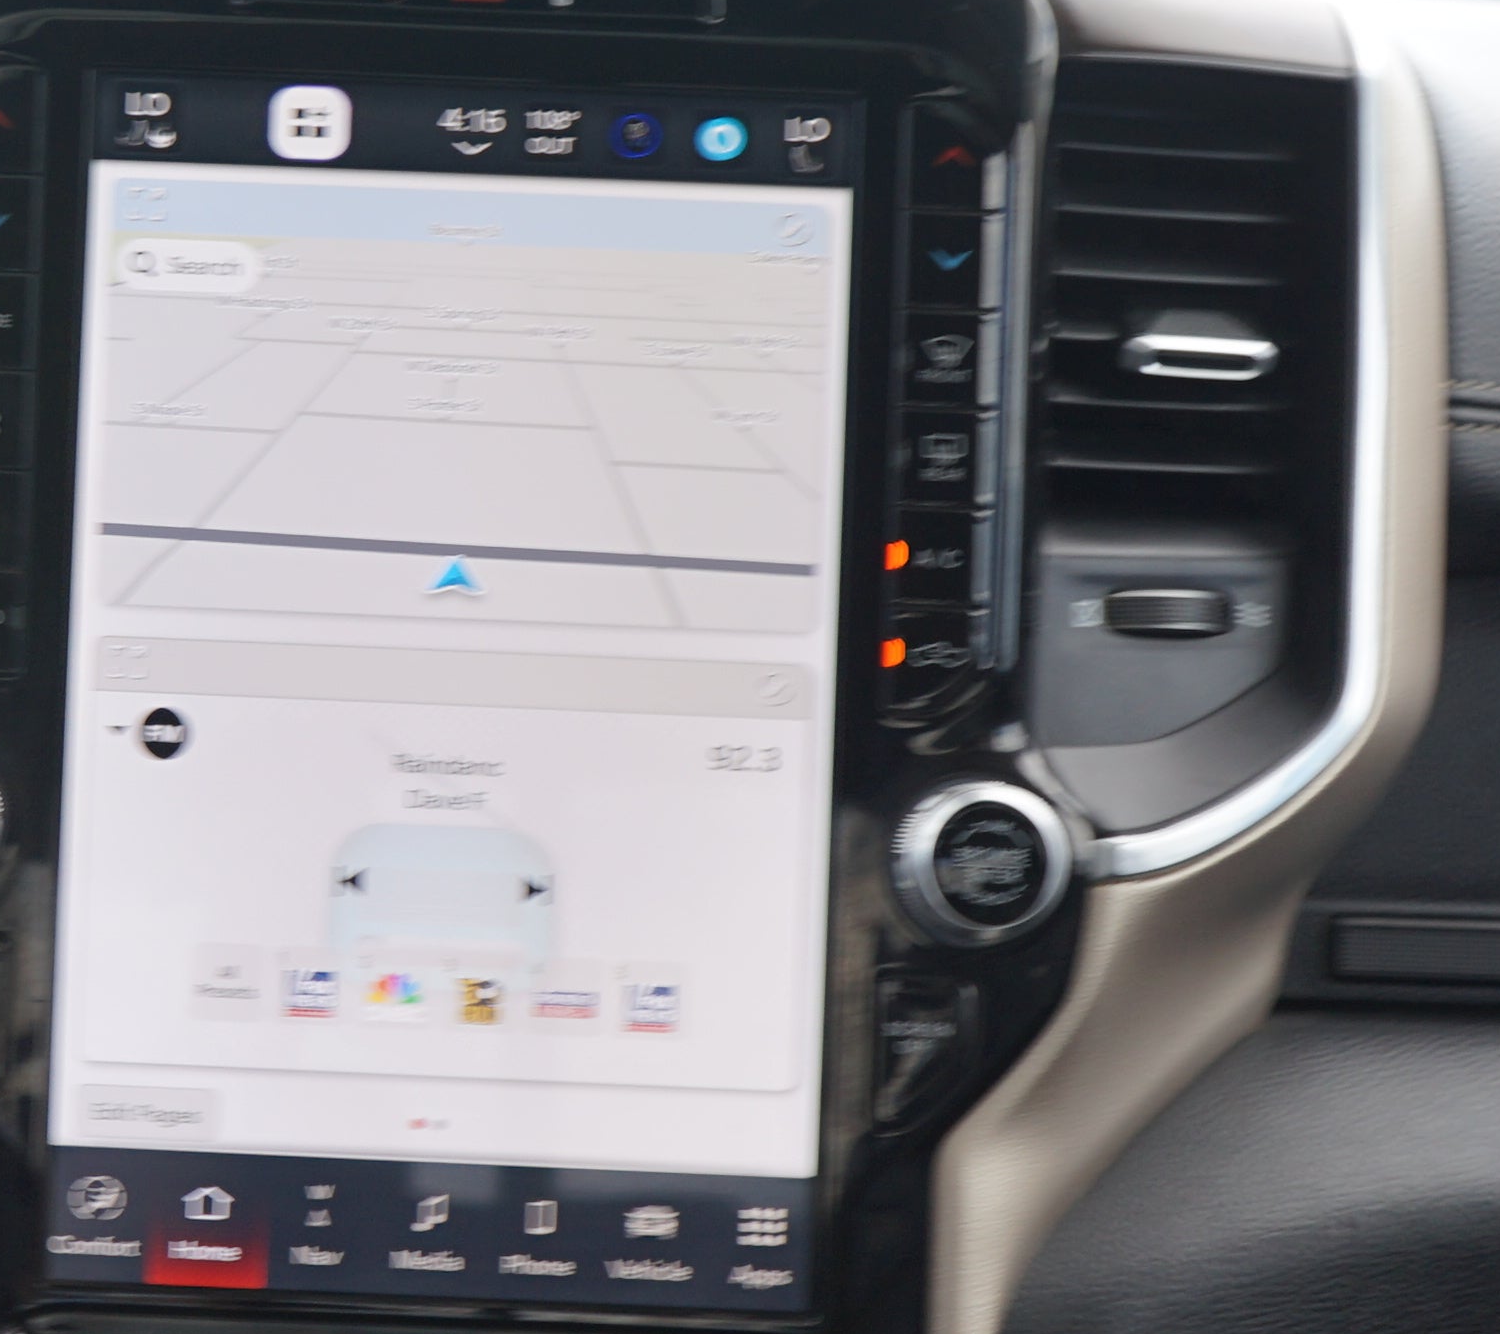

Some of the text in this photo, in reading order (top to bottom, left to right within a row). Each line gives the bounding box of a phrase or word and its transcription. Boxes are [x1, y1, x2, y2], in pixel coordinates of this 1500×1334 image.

[124, 92, 171, 117] LO
[784, 116, 832, 143] LO
[165, 255, 245, 276] Search
[705, 743, 783, 773] 92.3
[46, 1234, 142, 1257] Comfort
[167, 1239, 243, 1262] Home
[289, 1244, 344, 1266] Nav
[389, 1250, 466, 1272] Media
[498, 1253, 577, 1276] Phone
[603, 1259, 694, 1282] Vehicle
[727, 1264, 794, 1290] Apps
